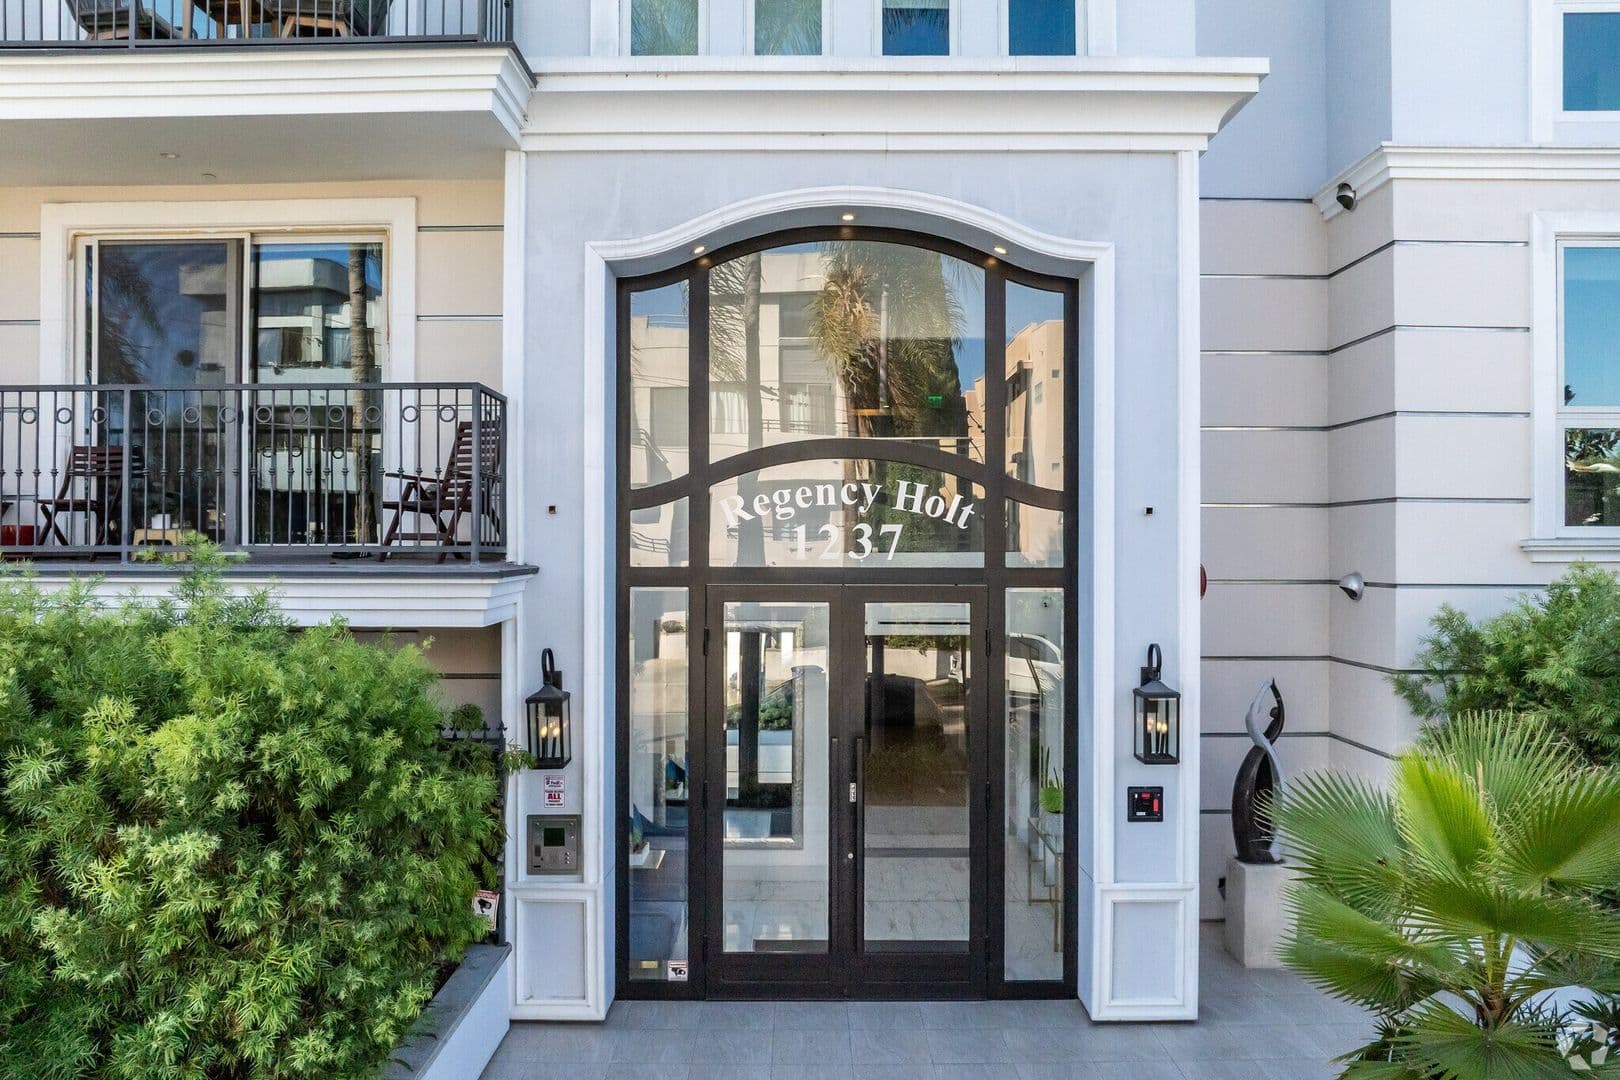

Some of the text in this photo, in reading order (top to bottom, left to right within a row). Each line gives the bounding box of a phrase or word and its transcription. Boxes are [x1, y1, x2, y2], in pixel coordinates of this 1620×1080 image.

[719, 479, 976, 529] Regency Holt
[791, 522, 904, 561] 1237
